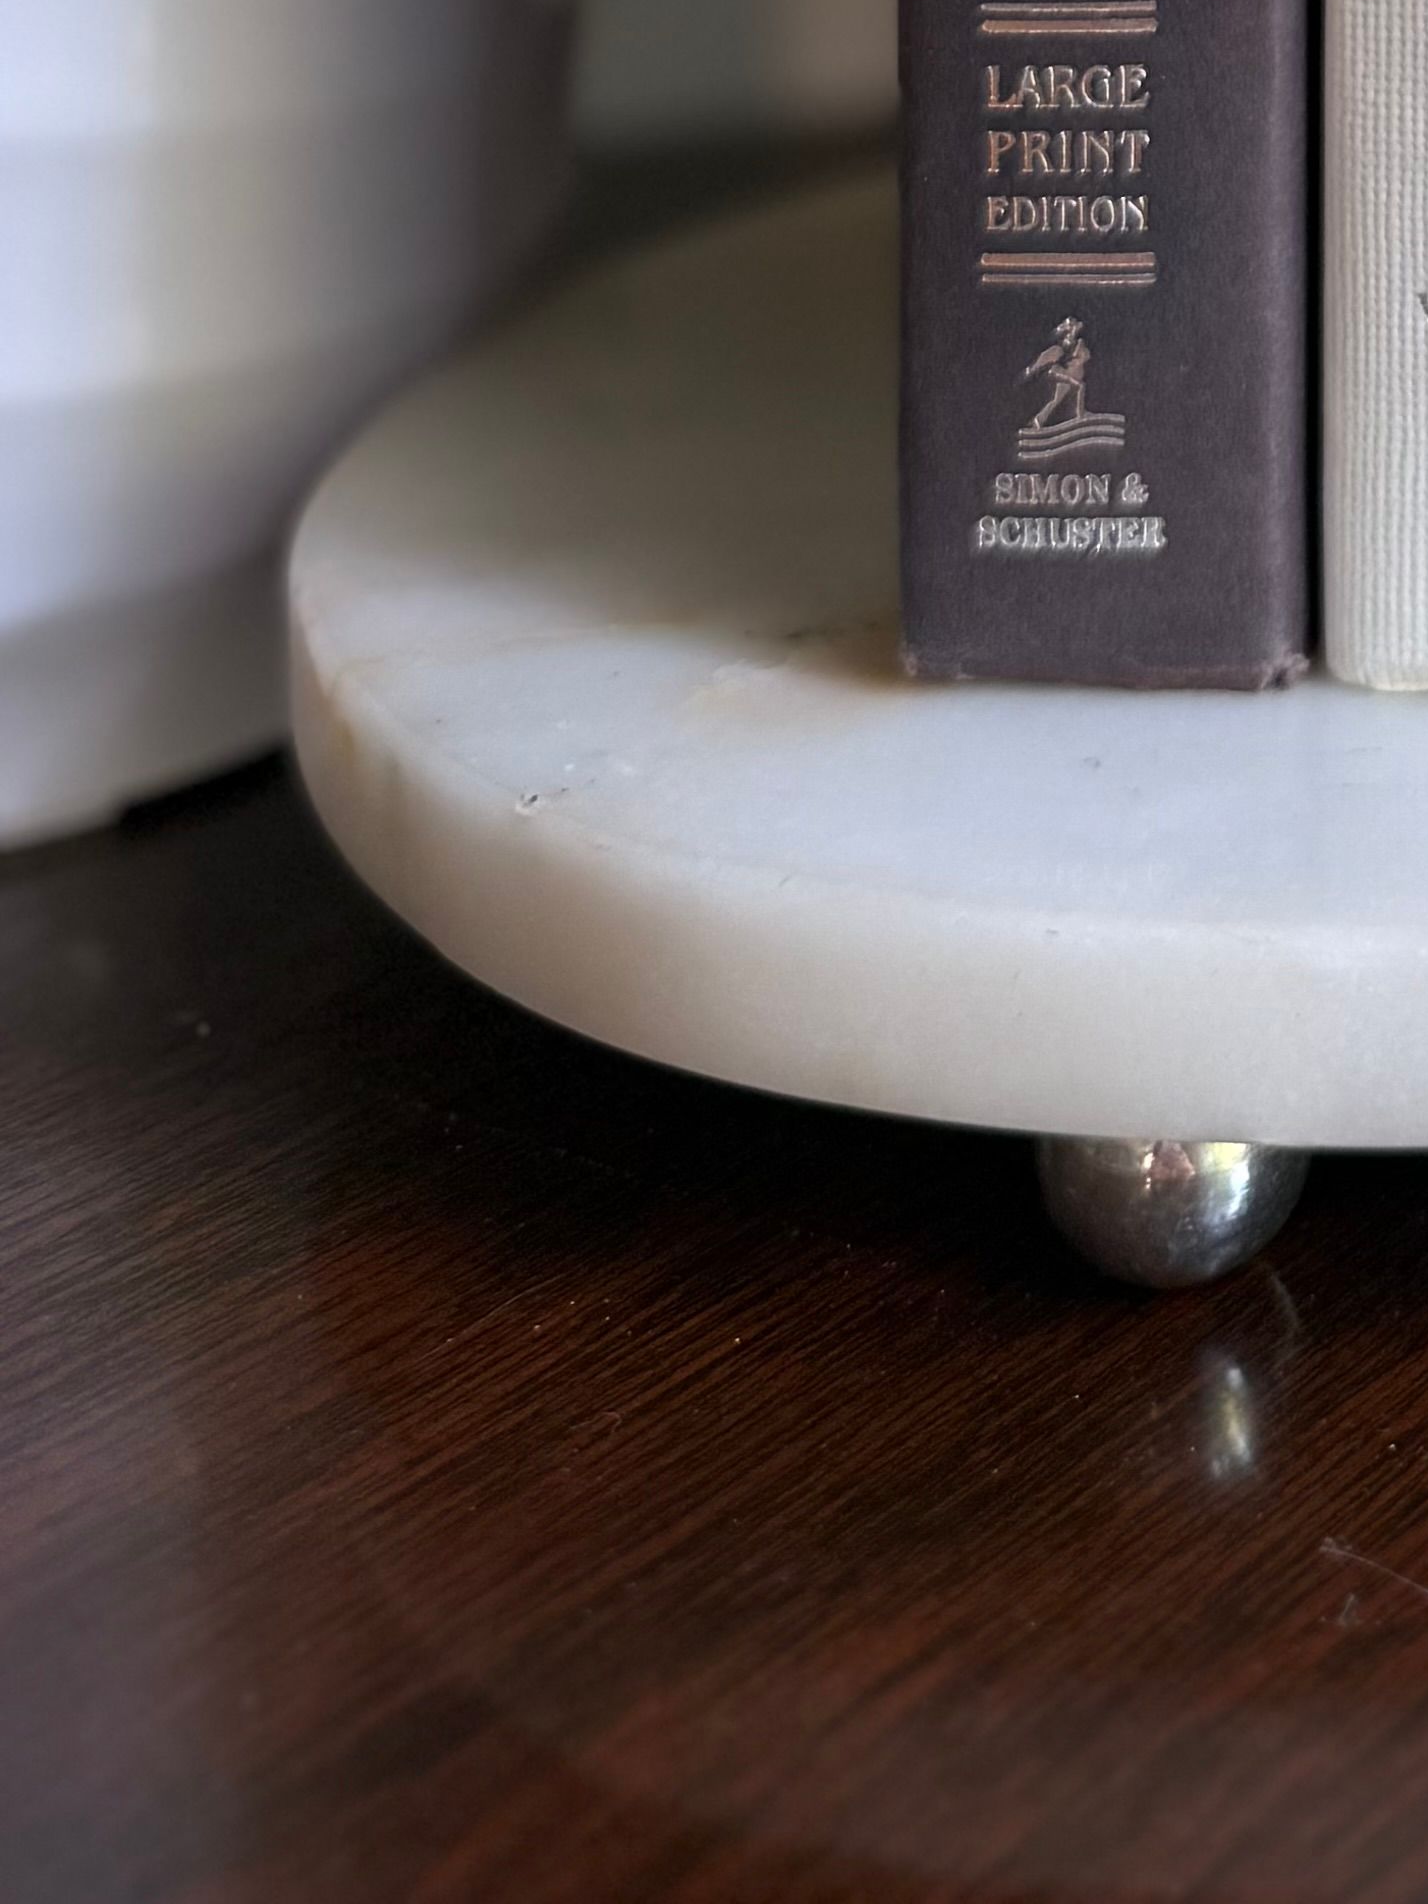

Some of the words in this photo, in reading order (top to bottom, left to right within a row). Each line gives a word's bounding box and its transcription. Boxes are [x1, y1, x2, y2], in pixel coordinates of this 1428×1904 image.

[983, 62, 1151, 109] LARGE
[985, 128, 1151, 176] PRINT
[984, 194, 1150, 235] EDITION
[993, 473, 1111, 506] SIMON
[1120, 473, 1149, 506] &
[975, 516, 1167, 552] SCHUSTER
